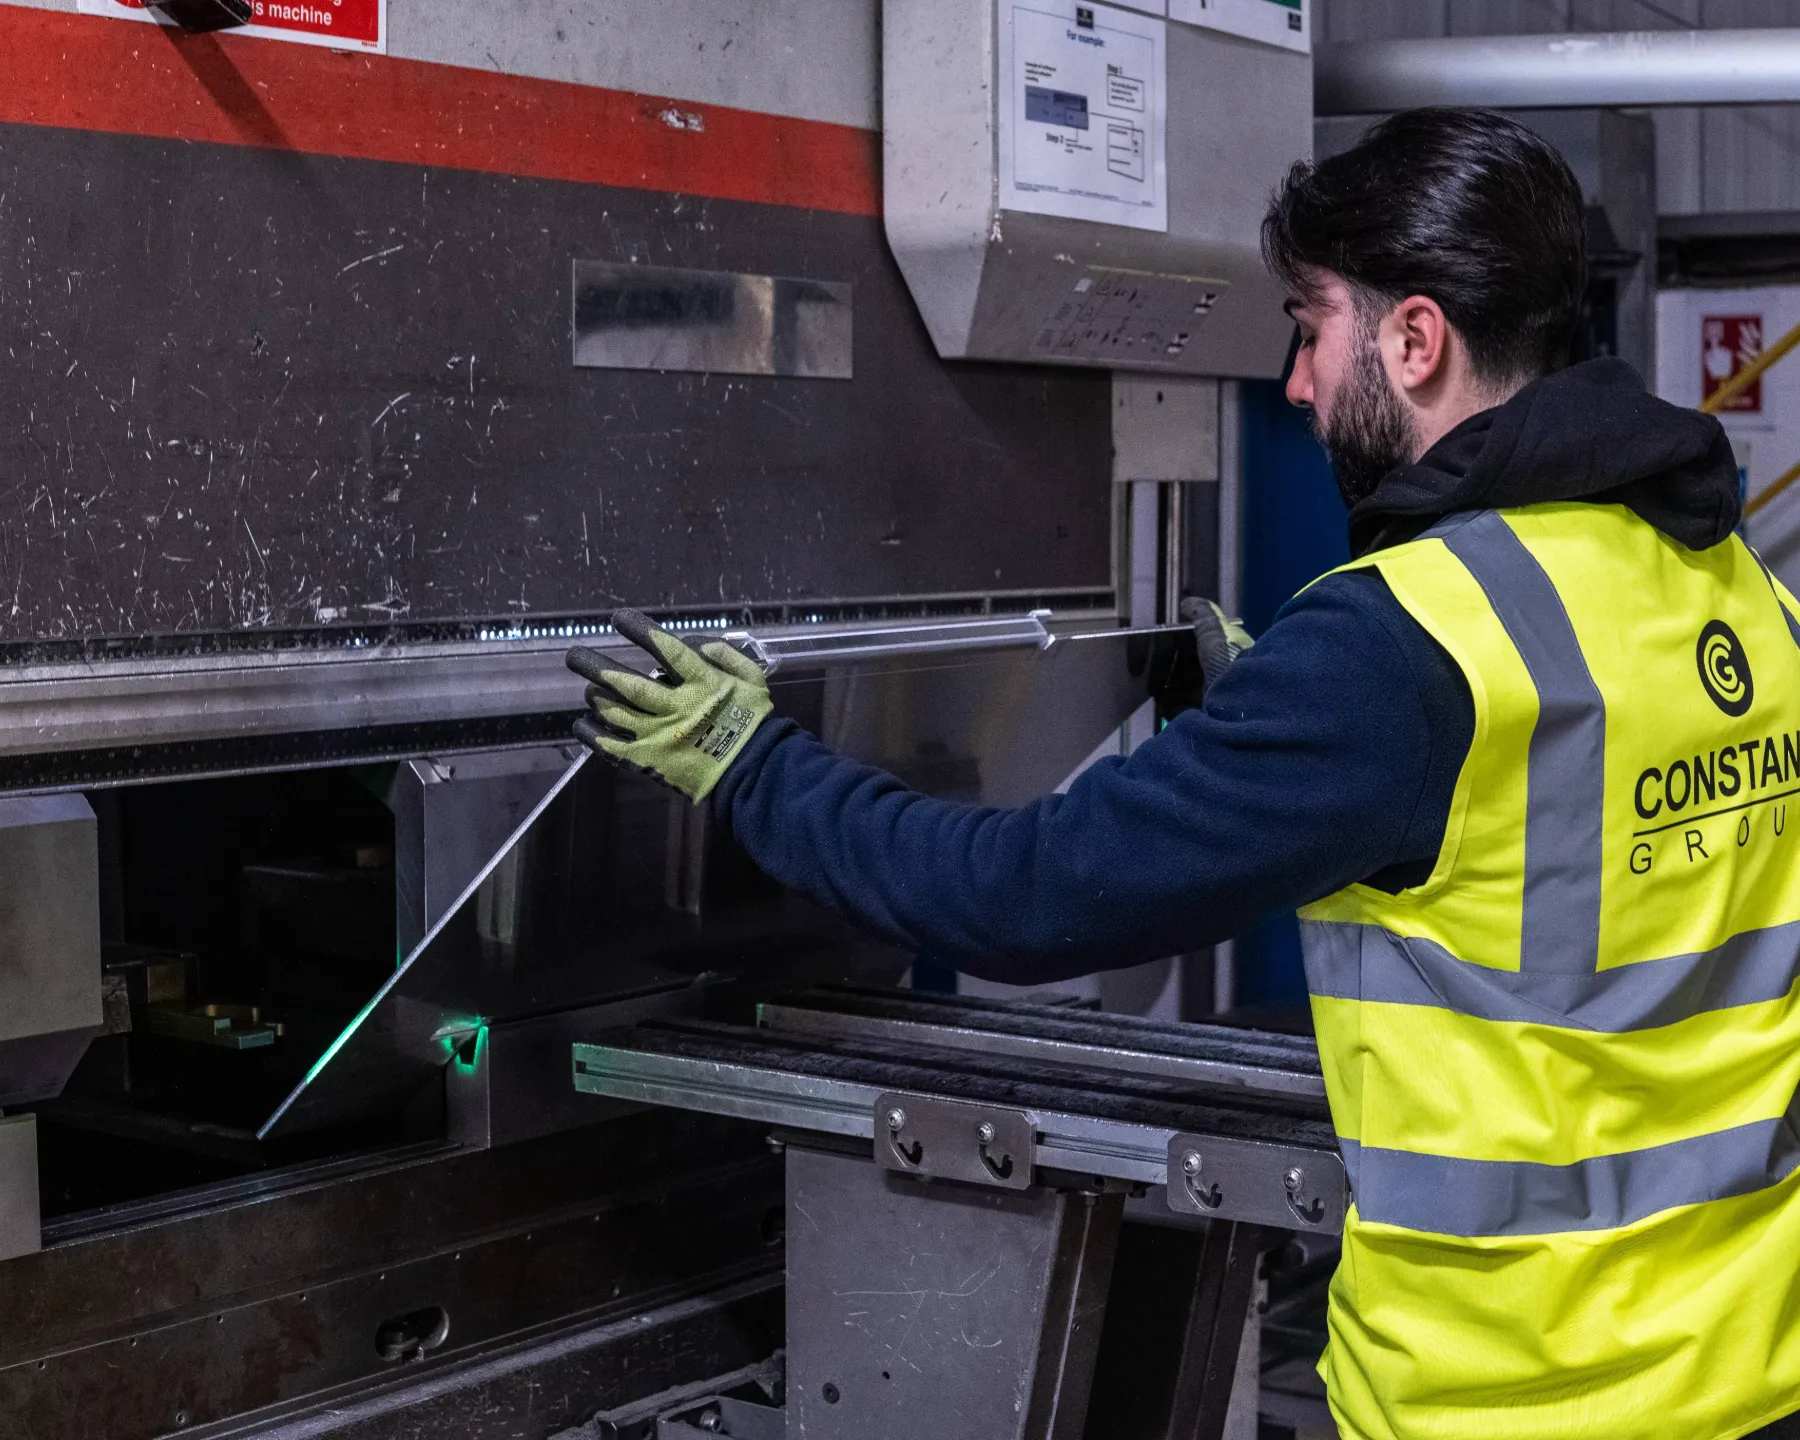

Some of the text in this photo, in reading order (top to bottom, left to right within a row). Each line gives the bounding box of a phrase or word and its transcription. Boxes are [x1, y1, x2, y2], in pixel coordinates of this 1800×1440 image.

[268, 4, 332, 26] machine
[1046, 132, 1059, 144] Step
[1634, 730, 1800, 820] CONSTAN
